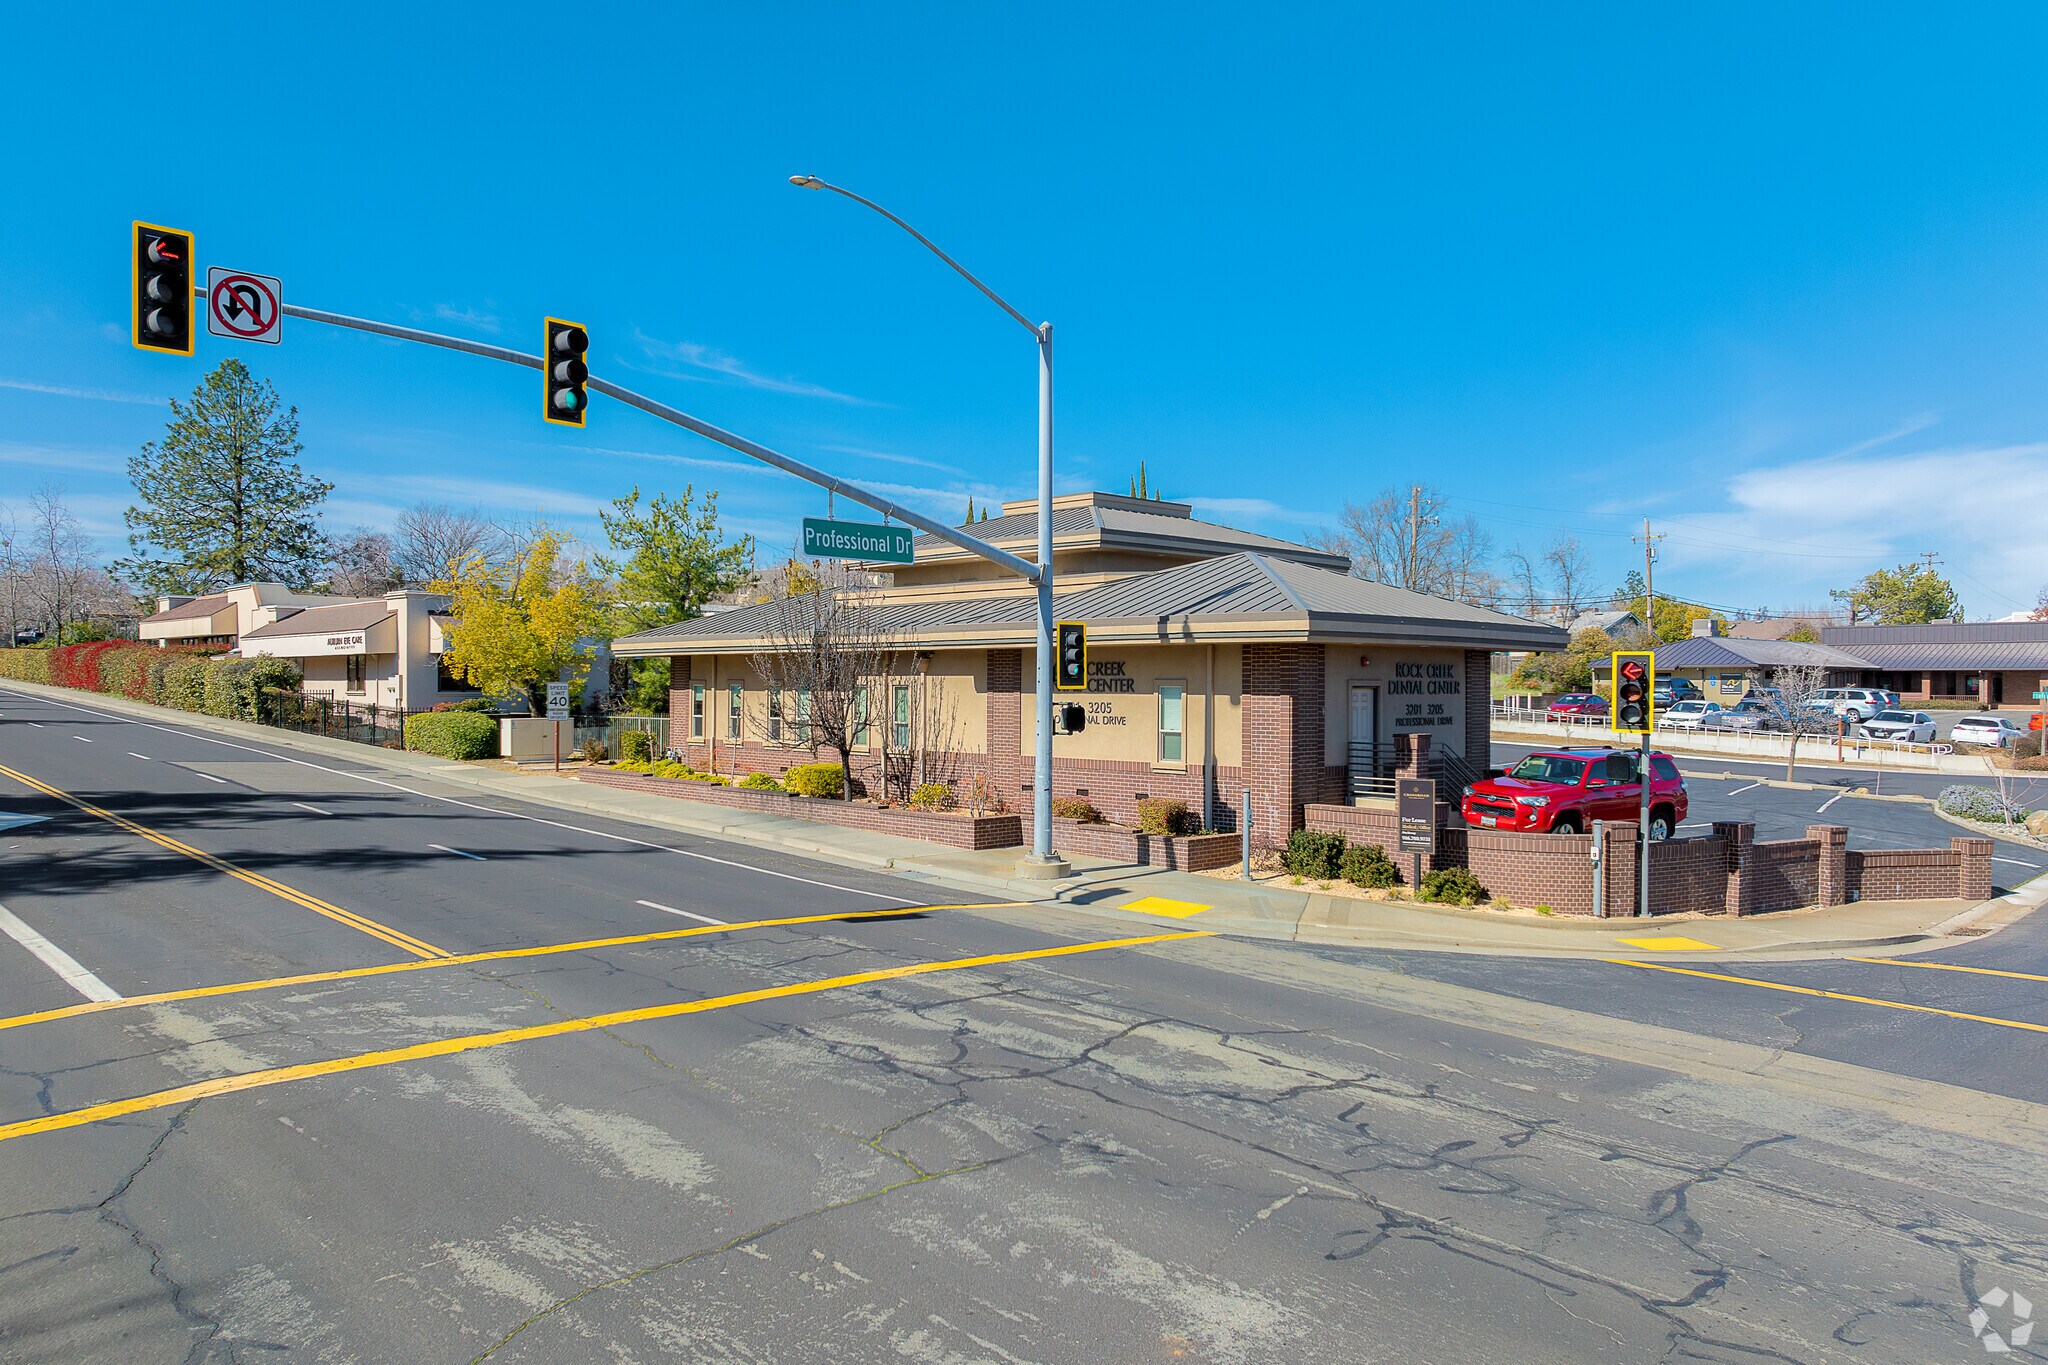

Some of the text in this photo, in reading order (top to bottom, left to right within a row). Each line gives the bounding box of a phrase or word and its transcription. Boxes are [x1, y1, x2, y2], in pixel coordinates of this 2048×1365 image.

[805, 527, 911, 554] Professional Dr
[352, 635, 363, 644] CARE
[1087, 661, 1127, 676] CREEK
[1395, 662, 1455, 679] ROCK CREEK
[1087, 678, 1136, 693] CENTER
[1388, 680, 1460, 695] DENTAL CENTER
[550, 696, 568, 707] 40
[1088, 702, 1113, 714] 3205
[1405, 703, 1445, 715] 3201 3205
[1102, 715, 1127, 726] DRIVE
[1395, 716, 1454, 726] PROFESSIONAL DRIVE
